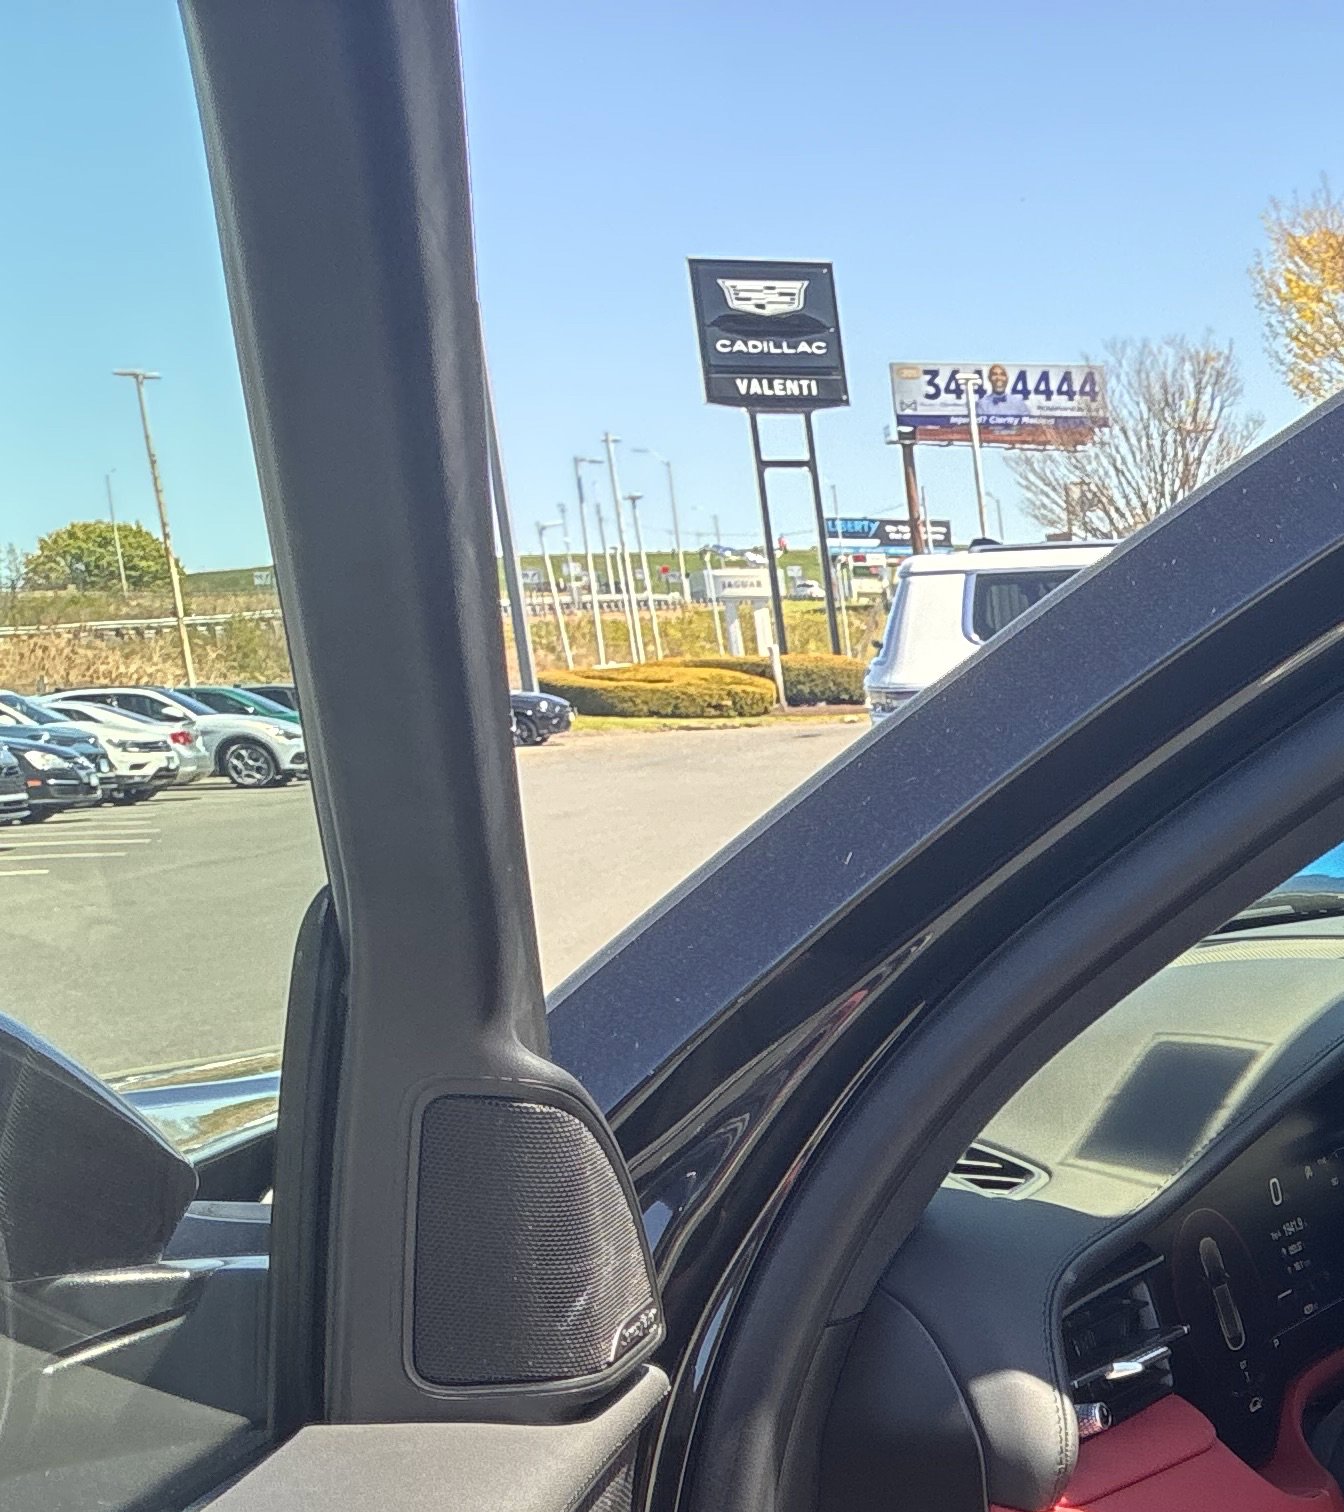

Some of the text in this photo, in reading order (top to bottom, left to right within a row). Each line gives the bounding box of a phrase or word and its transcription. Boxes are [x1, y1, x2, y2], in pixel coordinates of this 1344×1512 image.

[715, 339, 828, 355] CADILLAC
[734, 377, 819, 396] VALENTI
[1010, 369, 1098, 402] 4444
[721, 580, 762, 589] JAGUAR
